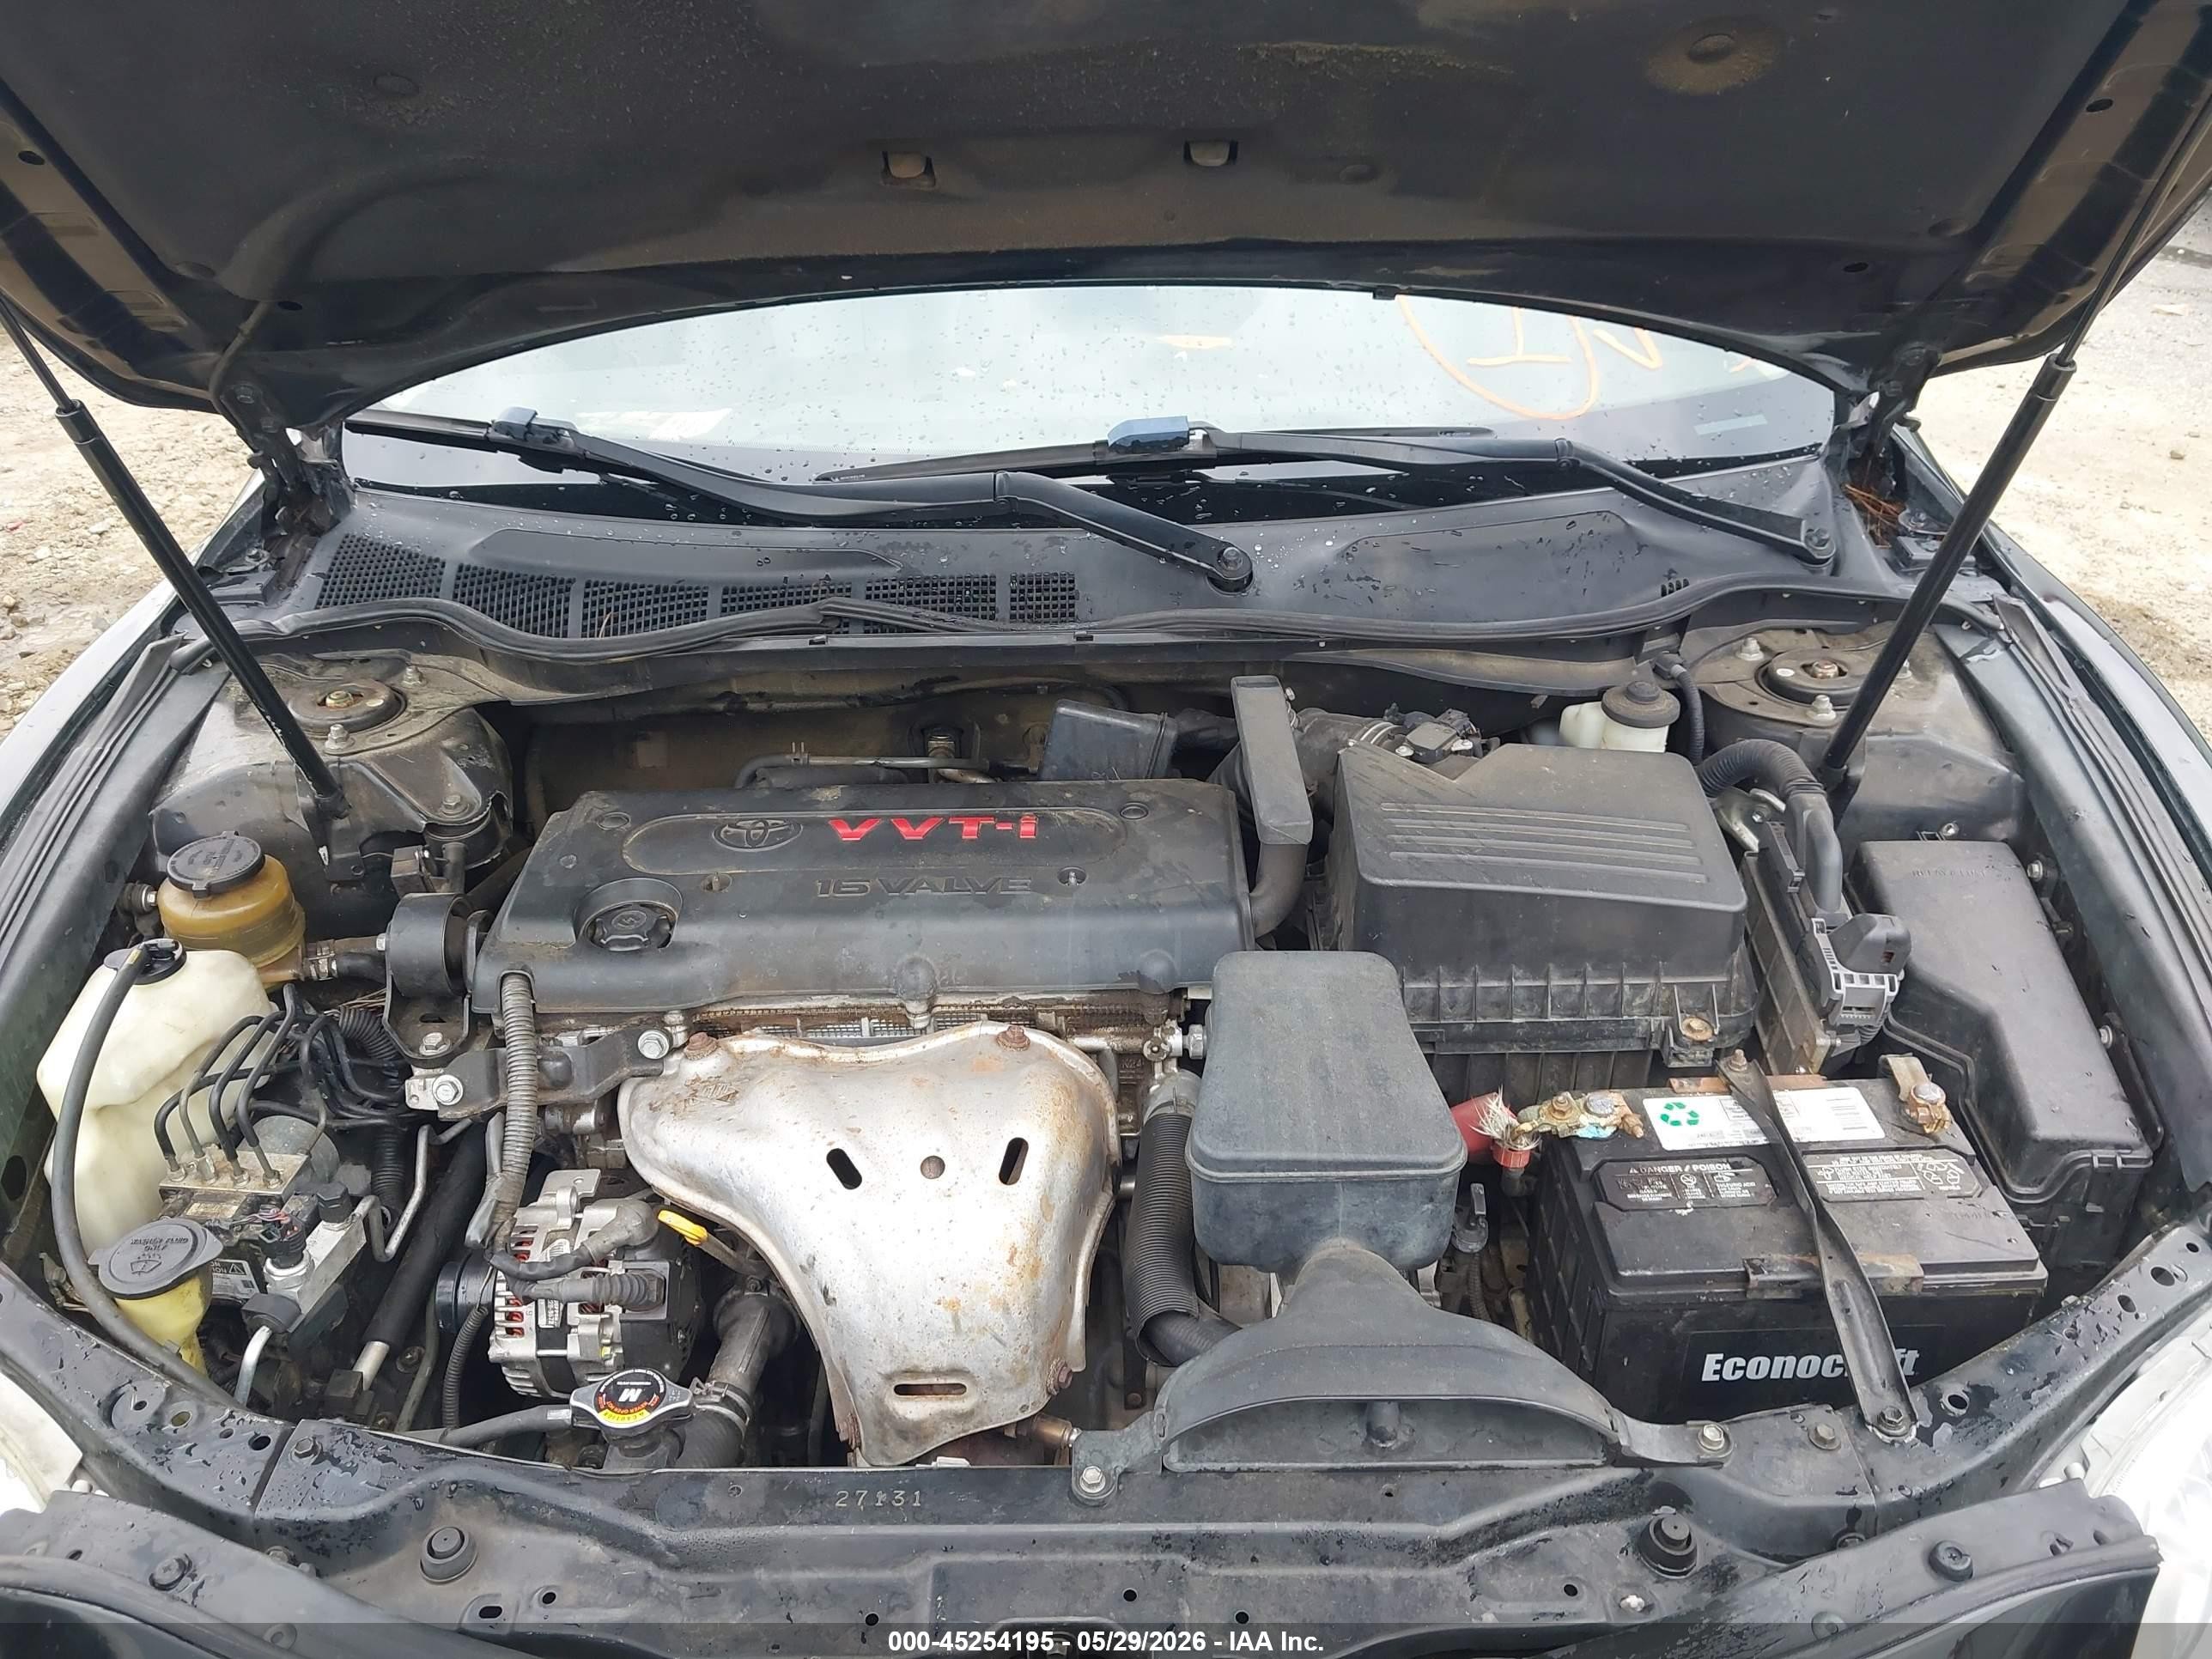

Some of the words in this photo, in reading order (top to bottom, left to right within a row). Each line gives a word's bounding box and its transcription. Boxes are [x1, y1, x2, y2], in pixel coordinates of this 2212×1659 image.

[828, 812, 1037, 841] VVT-i
[876, 877, 1032, 896] VALVE
[1639, 1164, 1683, 1174] DANGER
[1692, 1163, 1732, 1172] POISON
[1701, 1348, 1920, 1382] Econocft
